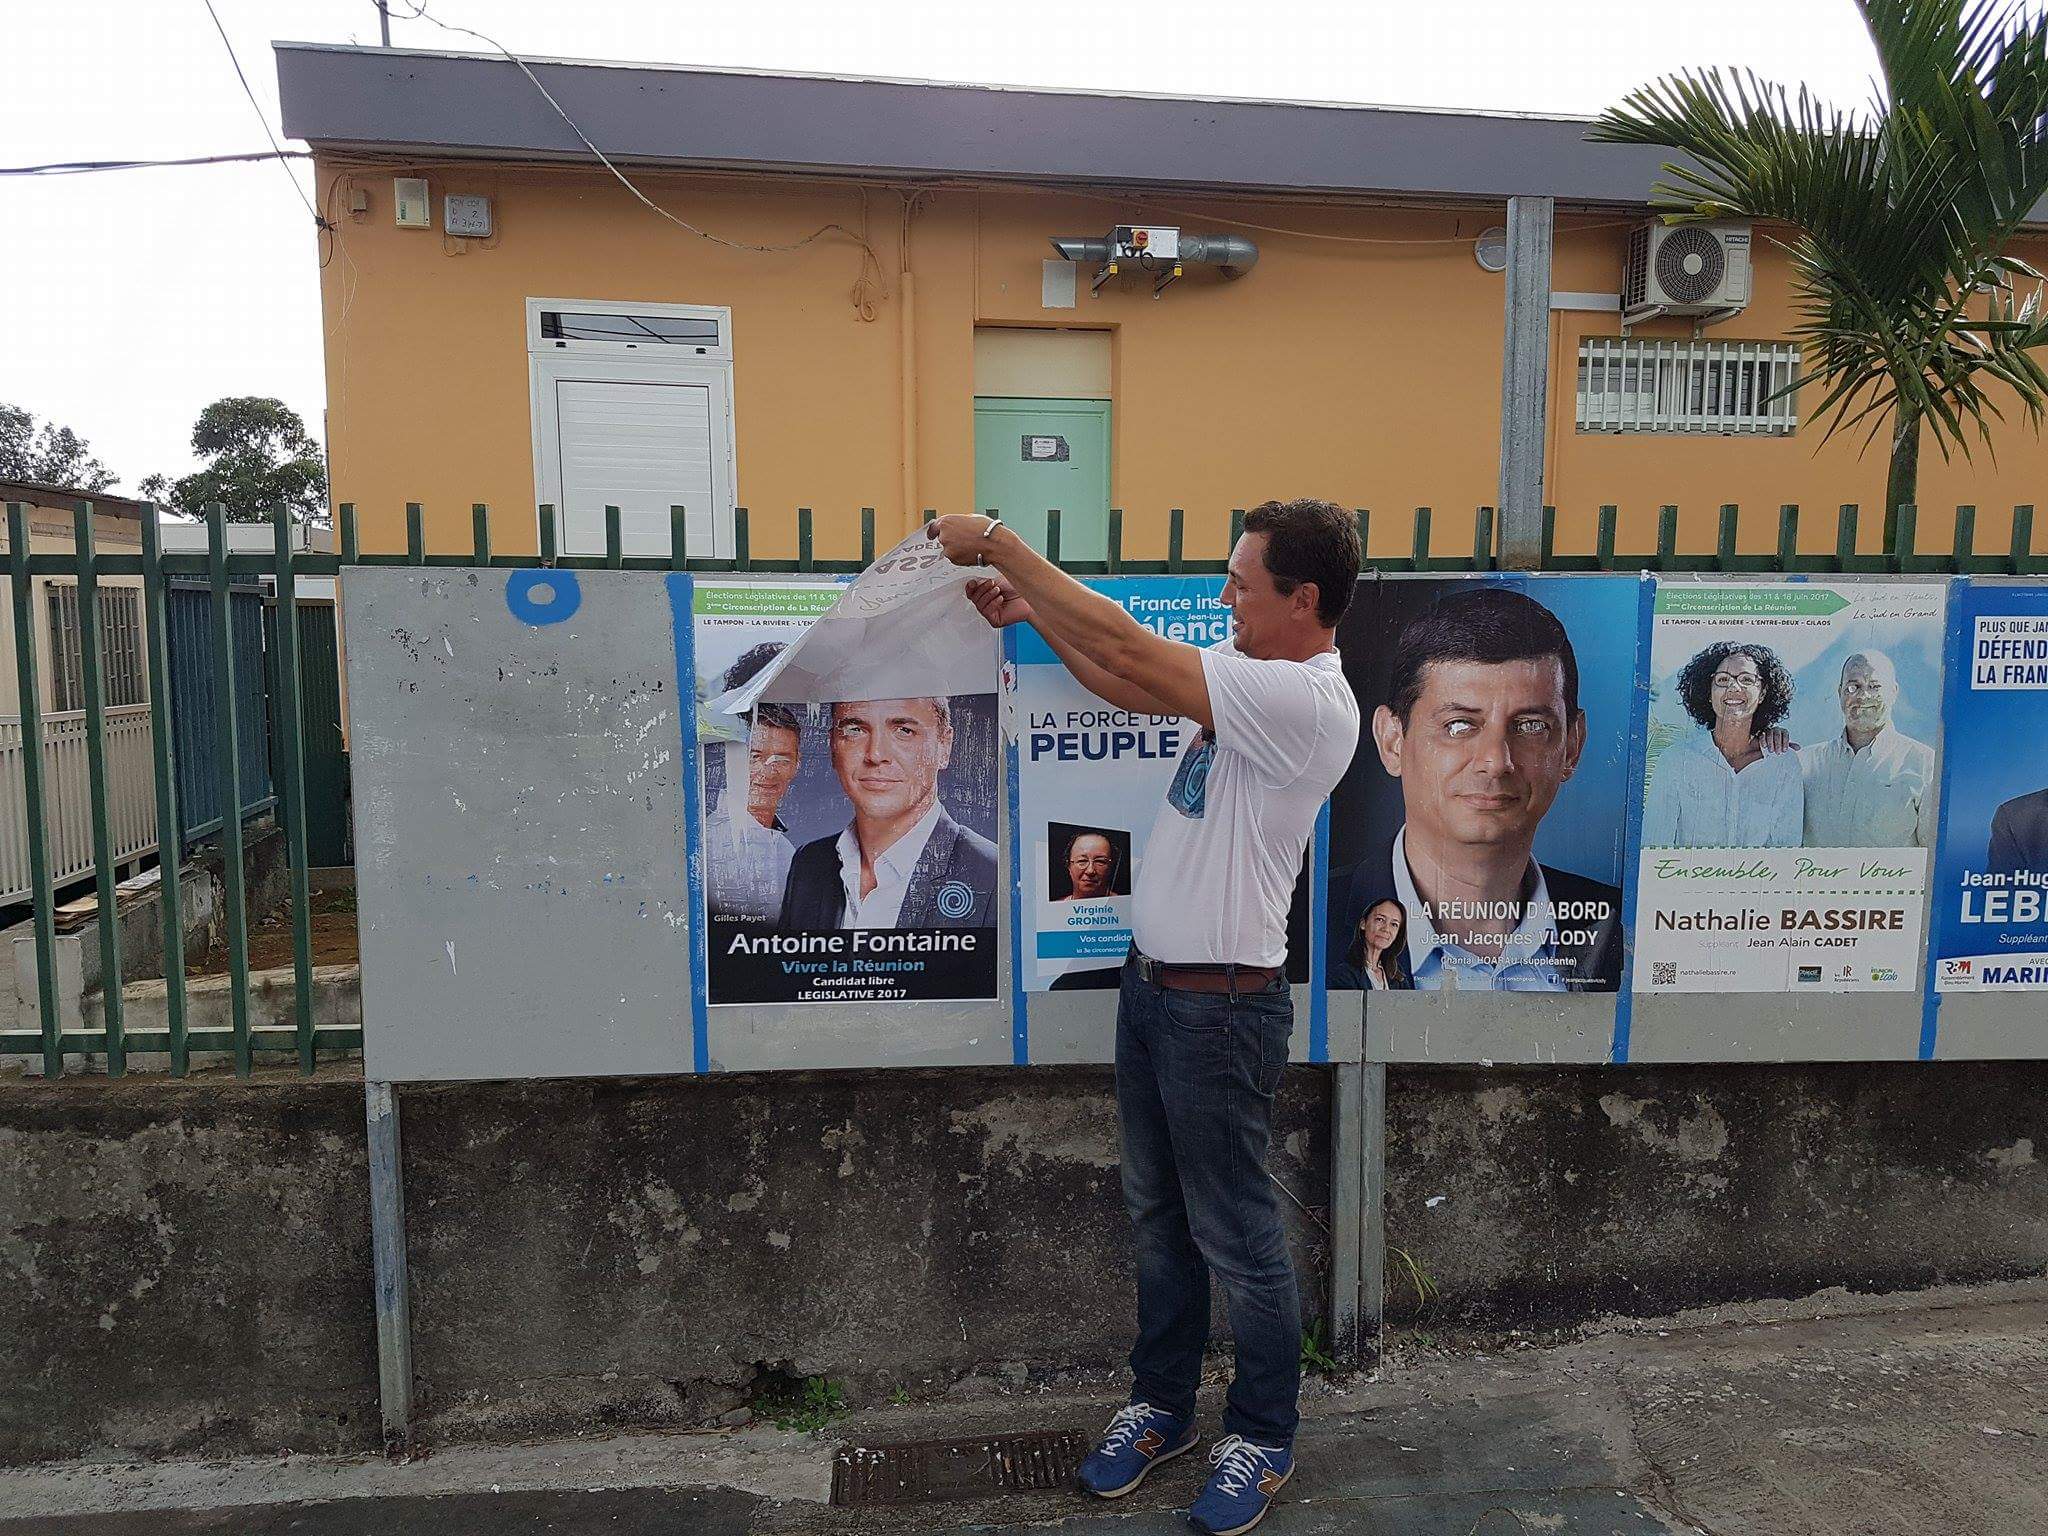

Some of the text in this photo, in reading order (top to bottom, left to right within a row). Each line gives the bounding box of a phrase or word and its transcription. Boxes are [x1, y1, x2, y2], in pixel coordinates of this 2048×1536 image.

[706, 591, 743, 600] Élections
[745, 592, 790, 601] Législatives
[1666, 591, 1702, 600] Élections
[1749, 592, 1762, 600] des
[1793, 594, 1808, 602] juin
[722, 603, 785, 612] Circonscription
[1129, 595, 1192, 611] France
[1681, 603, 1740, 612] Circonscription
[1765, 603, 1797, 611] Réunion
[1904, 607, 1937, 618] Grand
[1980, 621, 2006, 633] PLUS
[2009, 621, 2030, 633] QUE
[1977, 665, 1996, 684] LA
[1030, 711, 1180, 729] LA FORCE DU
[1030, 730, 1180, 762] PEUPLE
[1654, 859, 1778, 881] Ensemble,
[1793, 857, 1849, 880] Pour
[1073, 905, 1113, 915] Virginie
[1410, 897, 1610, 920] LA RÉUNION D'ABORD
[1960, 890, 2048, 923] LEB
[714, 914, 766, 924] Gilles Payet
[1067, 916, 1119, 926] GRONDIN
[1654, 908, 1904, 931] Nathalie BASSIRE
[727, 930, 976, 955] Antoine Fontaine
[1080, 935, 1096, 943] Vos
[1420, 930, 1598, 948] Jean Jacques VLODY
[1747, 937, 1775, 948] Jean
[1779, 937, 1810, 947] Alain
[1814, 937, 1858, 947] CADET
[782, 958, 924, 974] Vivre la Réunion
[1520, 955, 1577, 967] (suppléante)
[812, 976, 894, 987] Candidat libre
[798, 989, 906, 1000] LEGISLATIVE 2017
